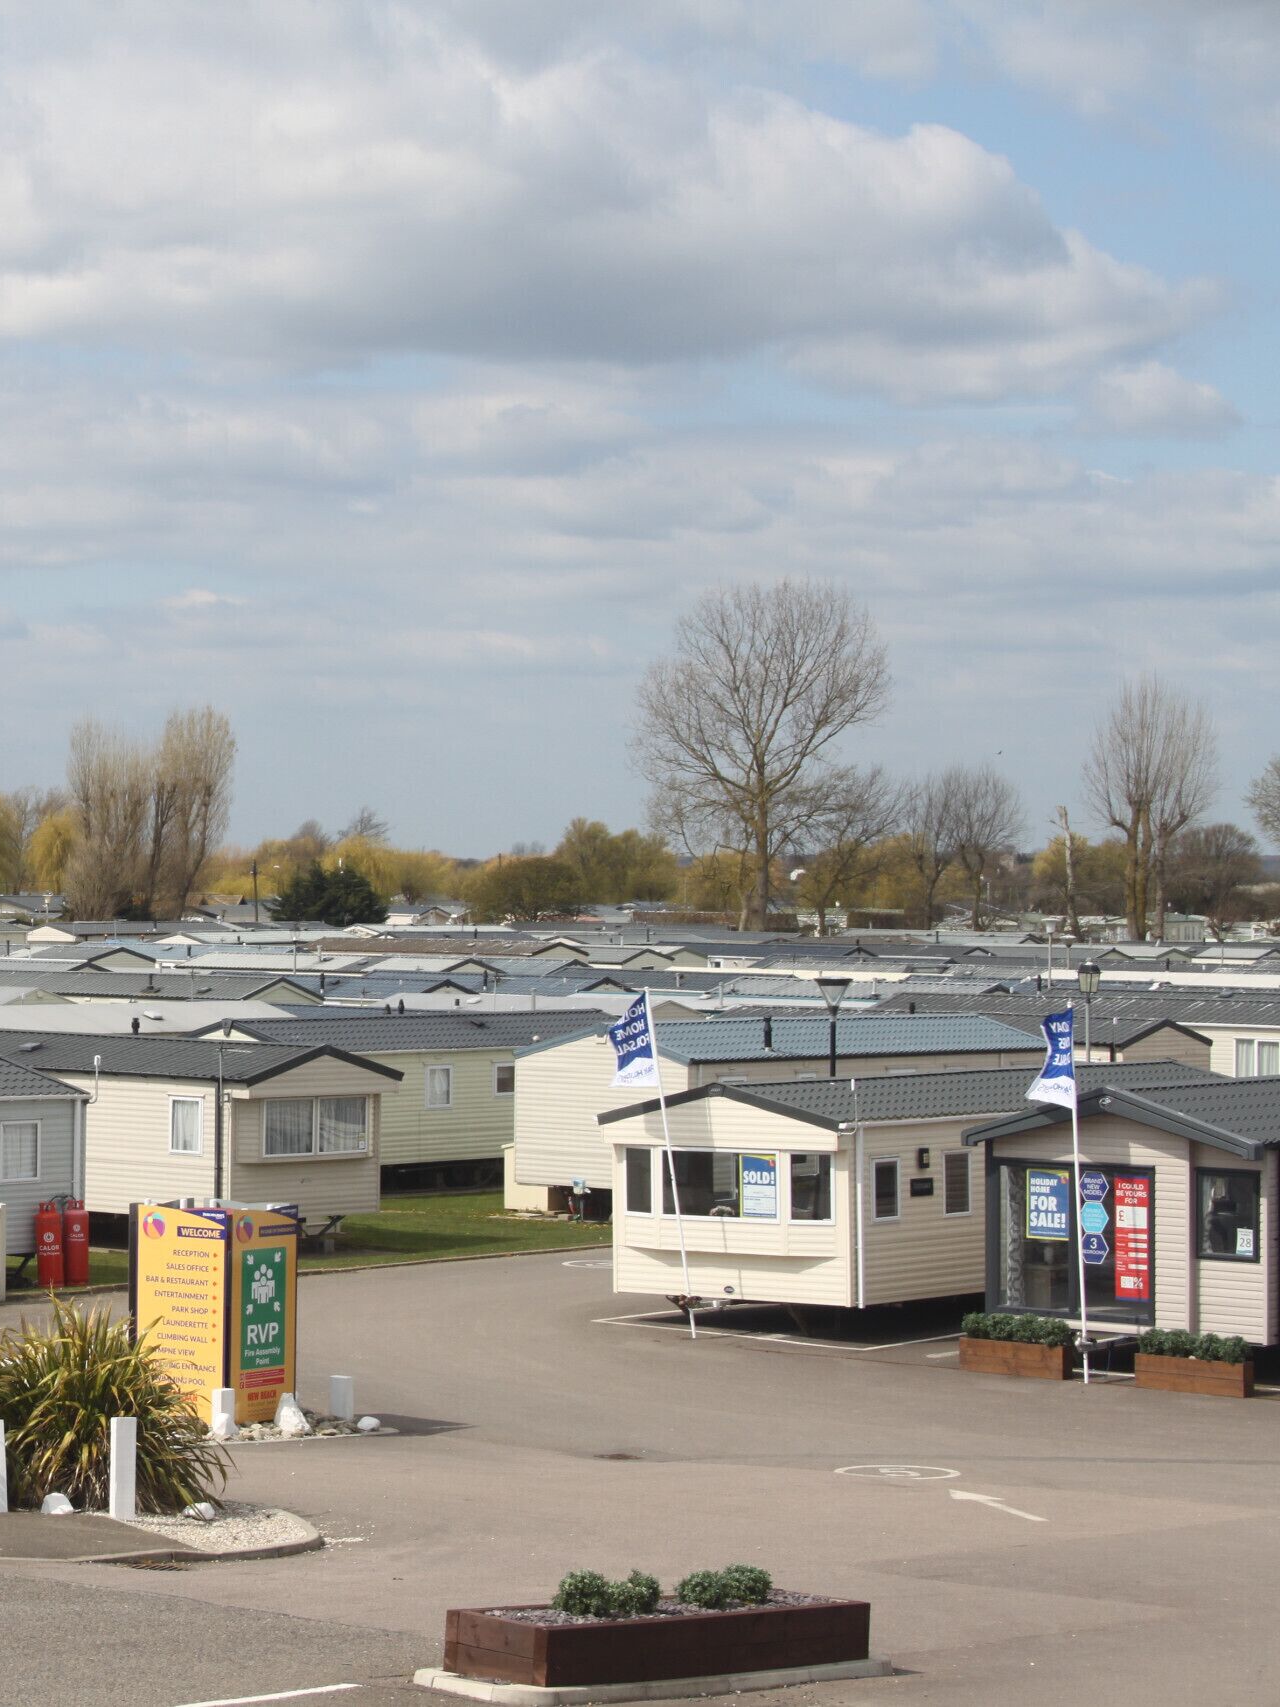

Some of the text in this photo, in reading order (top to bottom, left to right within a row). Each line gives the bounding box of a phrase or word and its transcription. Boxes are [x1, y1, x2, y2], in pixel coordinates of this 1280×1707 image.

[743, 1171, 775, 1185] SOLD!
[1030, 1178, 1058, 1186] HOLIDAY
[1030, 1195, 1057, 1211] FOR
[1029, 1212, 1066, 1228] SALE!
[180, 1227, 221, 1239] WELCOME
[1090, 1238, 1097, 1249] 3
[172, 1249, 210, 1258] RECEPTION
[166, 1263, 186, 1271] SALES
[166, 1276, 209, 1286] RESTAURANT
[154, 1289, 209, 1300] ENTERTAINMENT
[171, 1305, 209, 1315] PARK SHOP
[162, 1318, 209, 1329] LAUNDERETTE
[157, 1332, 209, 1343] CLIMBING WALL
[247, 1321, 279, 1345] RVP
[177, 1348, 196, 1356] VIEW
[181, 1362, 216, 1373] ENTRANCE
[188, 1377, 206, 1386] POOL
